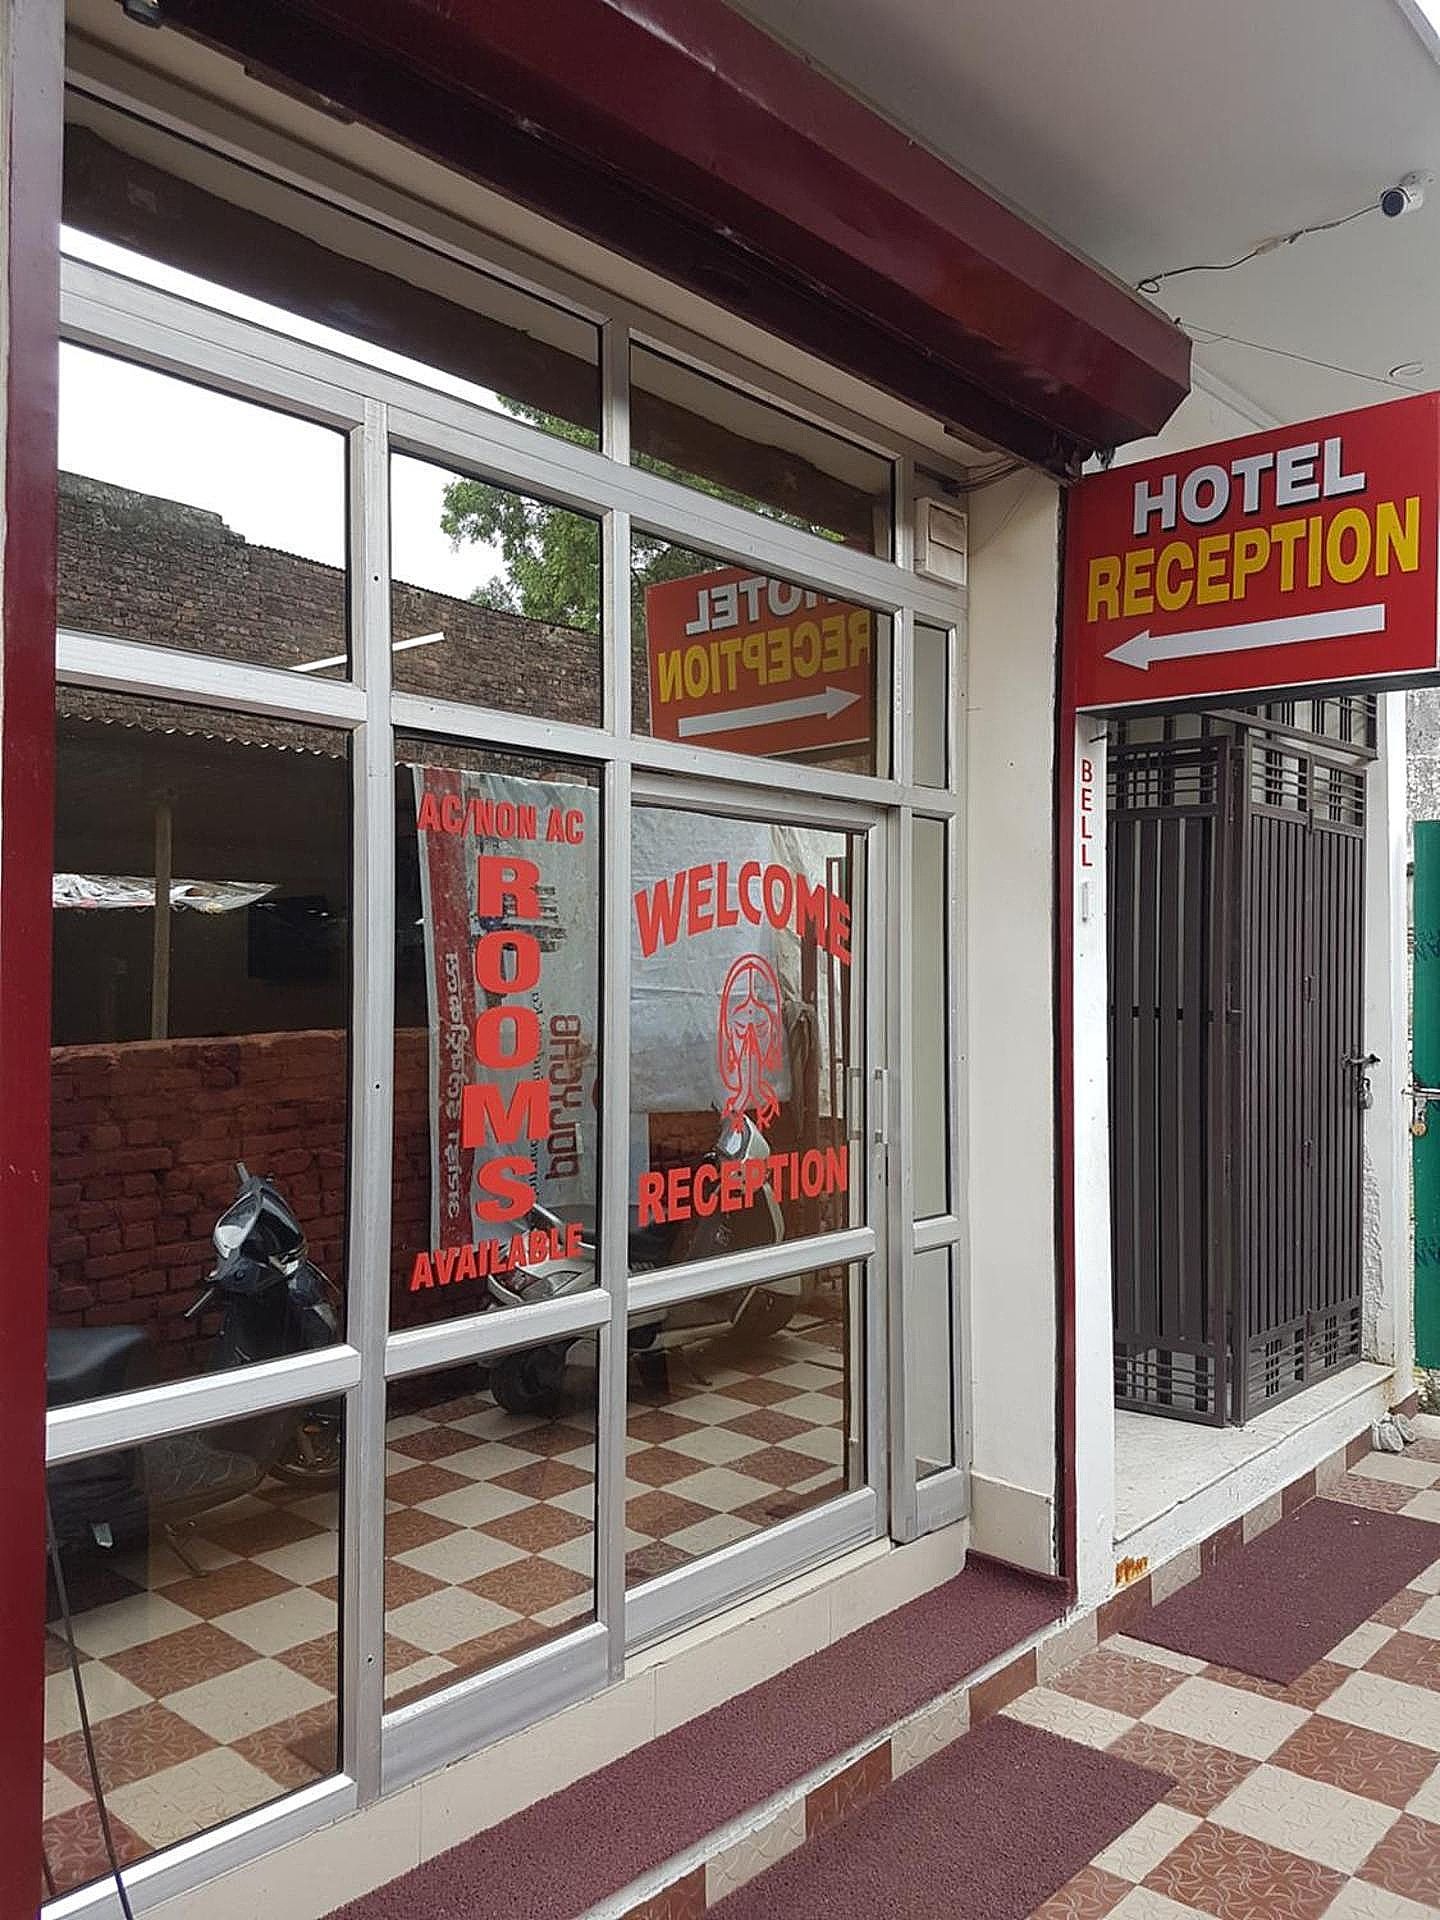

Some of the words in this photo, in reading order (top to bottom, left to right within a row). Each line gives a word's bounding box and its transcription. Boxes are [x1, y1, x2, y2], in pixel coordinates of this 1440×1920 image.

[1133, 436, 1366, 536] HOTEL
[1087, 496, 1421, 623] RECEPTION
[416, 793, 537, 840] AC/NON
[546, 807, 584, 845] AC
[1081, 758, 1093, 867] BELL
[633, 860, 853, 967] WELCOME
[462, 855, 550, 1223] ROOMS
[637, 1145, 848, 1229] RECEPTION
[410, 1222, 584, 1292] AVAILABLE
